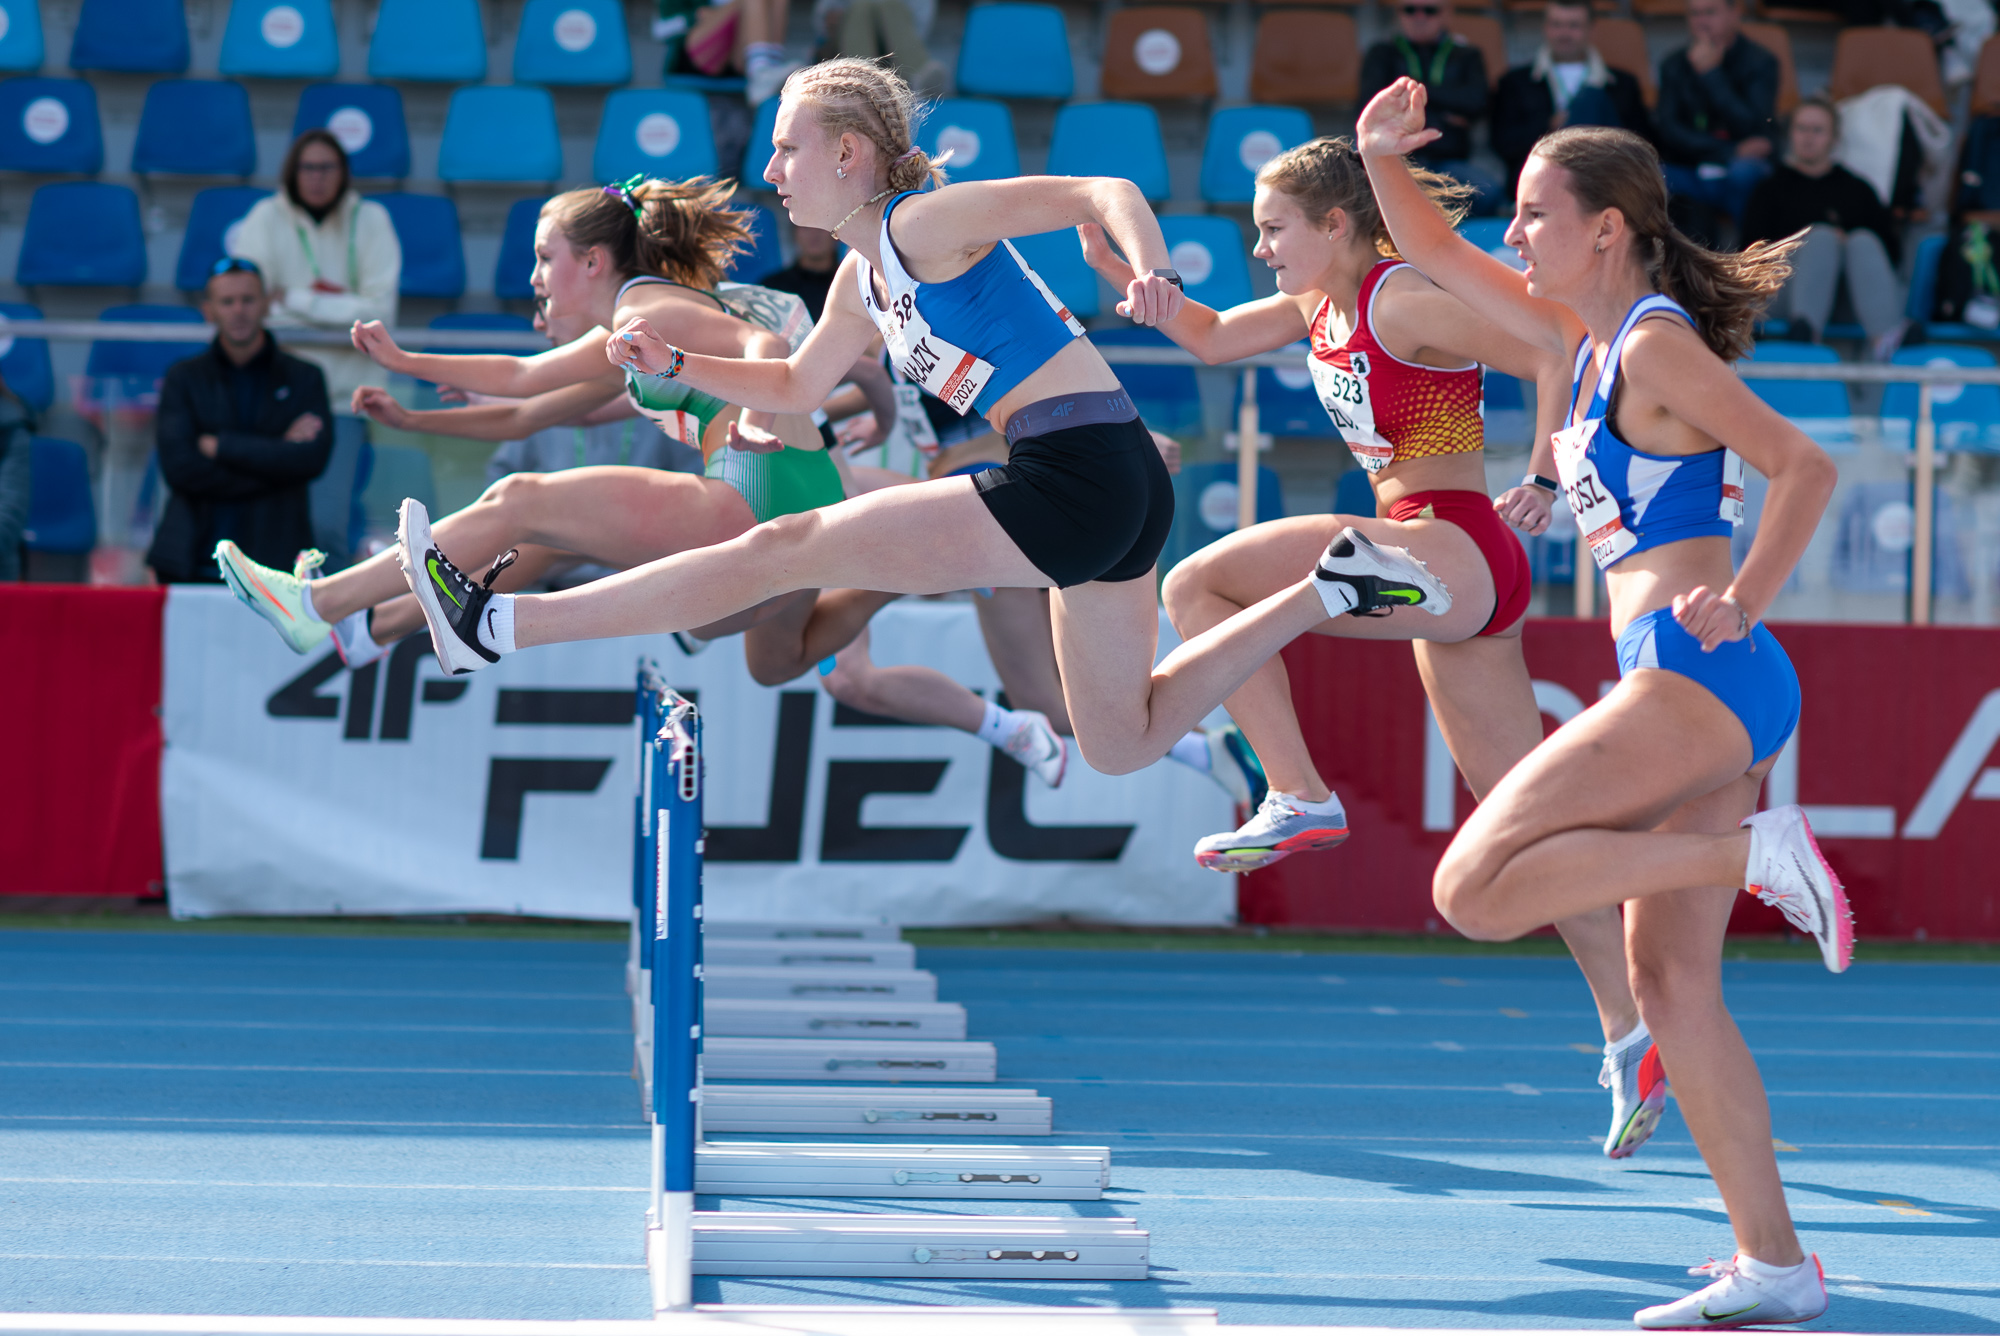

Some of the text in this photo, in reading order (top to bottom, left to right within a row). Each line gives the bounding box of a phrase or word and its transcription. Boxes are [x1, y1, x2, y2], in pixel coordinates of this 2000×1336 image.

[902, 337, 941, 385] AŁAZY
[953, 379, 977, 406] 2022
[1332, 373, 1363, 404] 523
[1051, 401, 1075, 417] 4F
[1594, 540, 1615, 562] 2022
[266, 631, 471, 741] 4F
